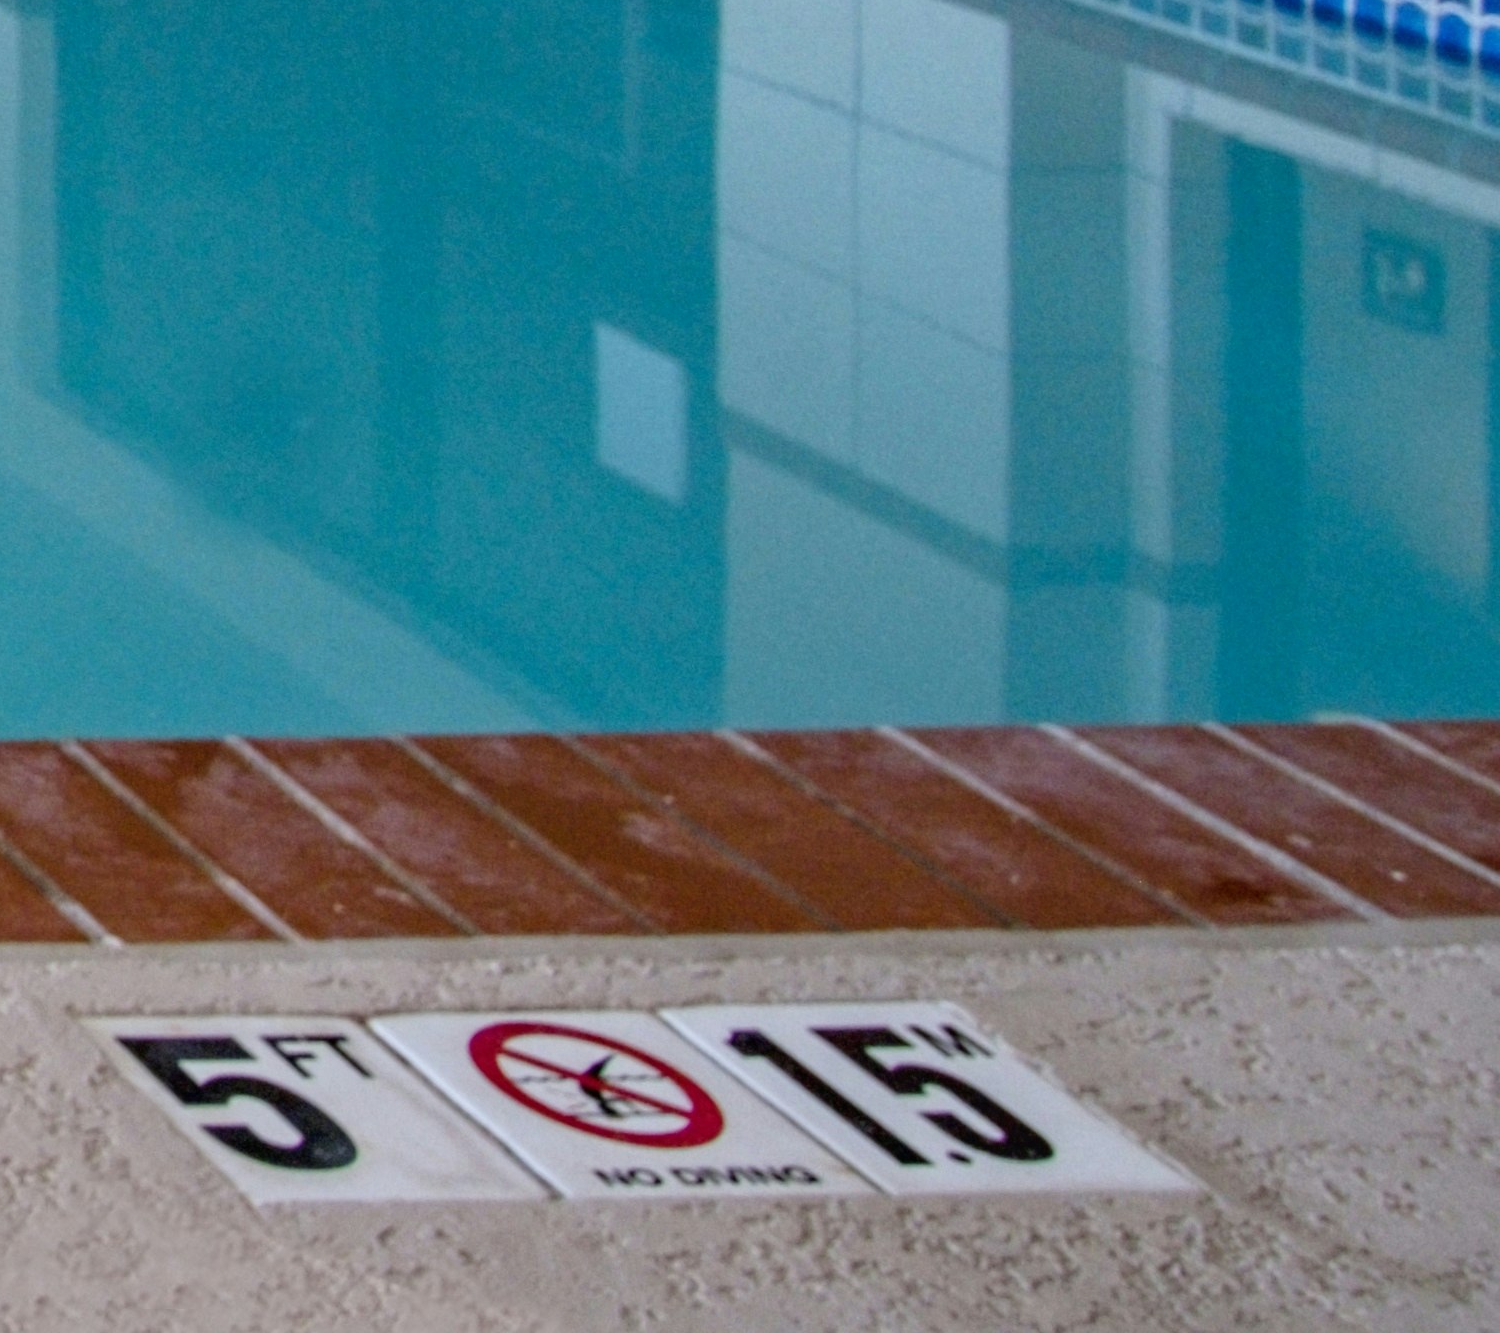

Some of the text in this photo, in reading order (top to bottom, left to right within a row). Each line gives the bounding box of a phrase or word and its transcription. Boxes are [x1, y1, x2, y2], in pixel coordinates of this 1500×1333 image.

[907, 1023, 994, 1057] M
[117, 1036, 373, 1169] 5 FT
[594, 1165, 819, 1186] NO DIVING
